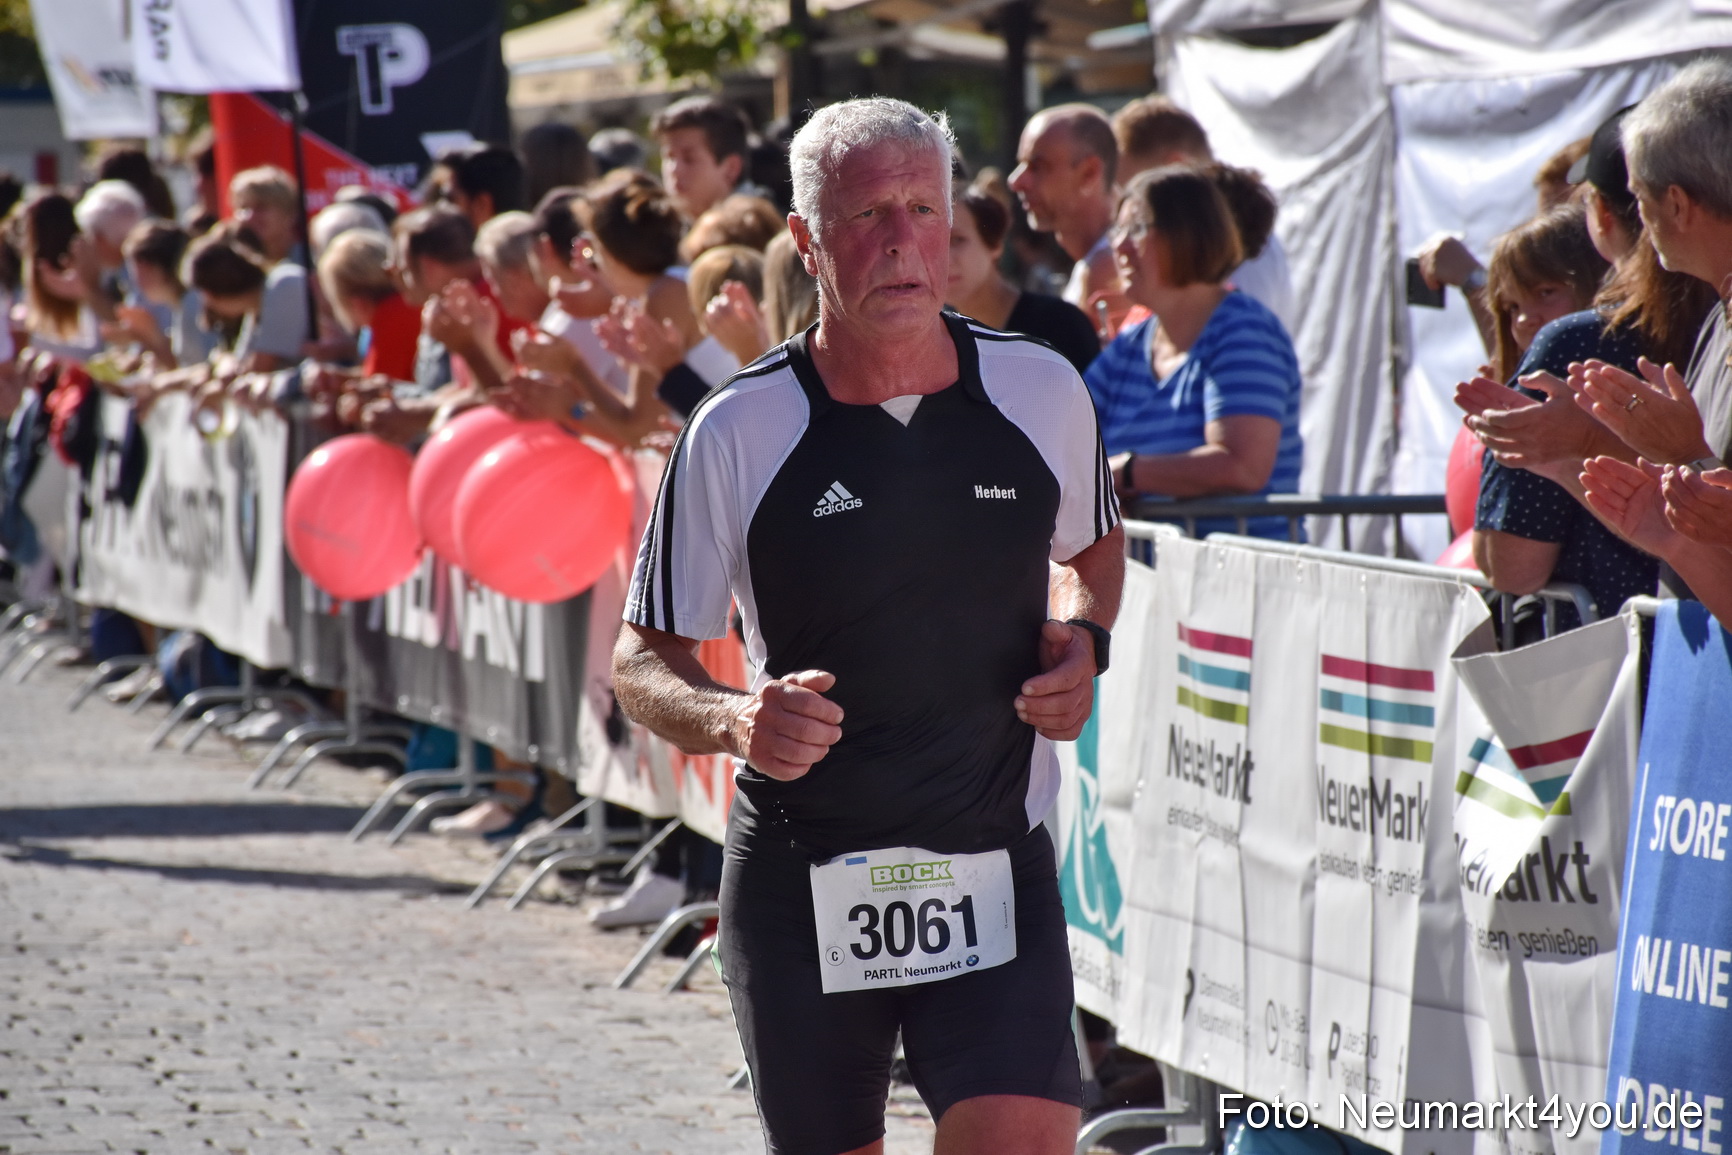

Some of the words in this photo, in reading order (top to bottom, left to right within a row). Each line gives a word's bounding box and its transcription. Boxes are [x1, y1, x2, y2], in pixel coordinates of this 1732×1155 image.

[974, 485, 1016, 499] Herbert
[813, 498, 863, 518] adidas
[1650, 795, 1731, 861] STORE
[870, 860, 953, 885] BOCK
[872, 885, 898, 893] inspired
[900, 884, 907, 892] by
[929, 881, 955, 889] concepts
[848, 895, 978, 960] 3061
[1518, 927, 1598, 958] genießen
[864, 967, 902, 980] PARTL
[904, 960, 962, 977] Neumarkt
[1631, 935, 1731, 1008] ONLINE
